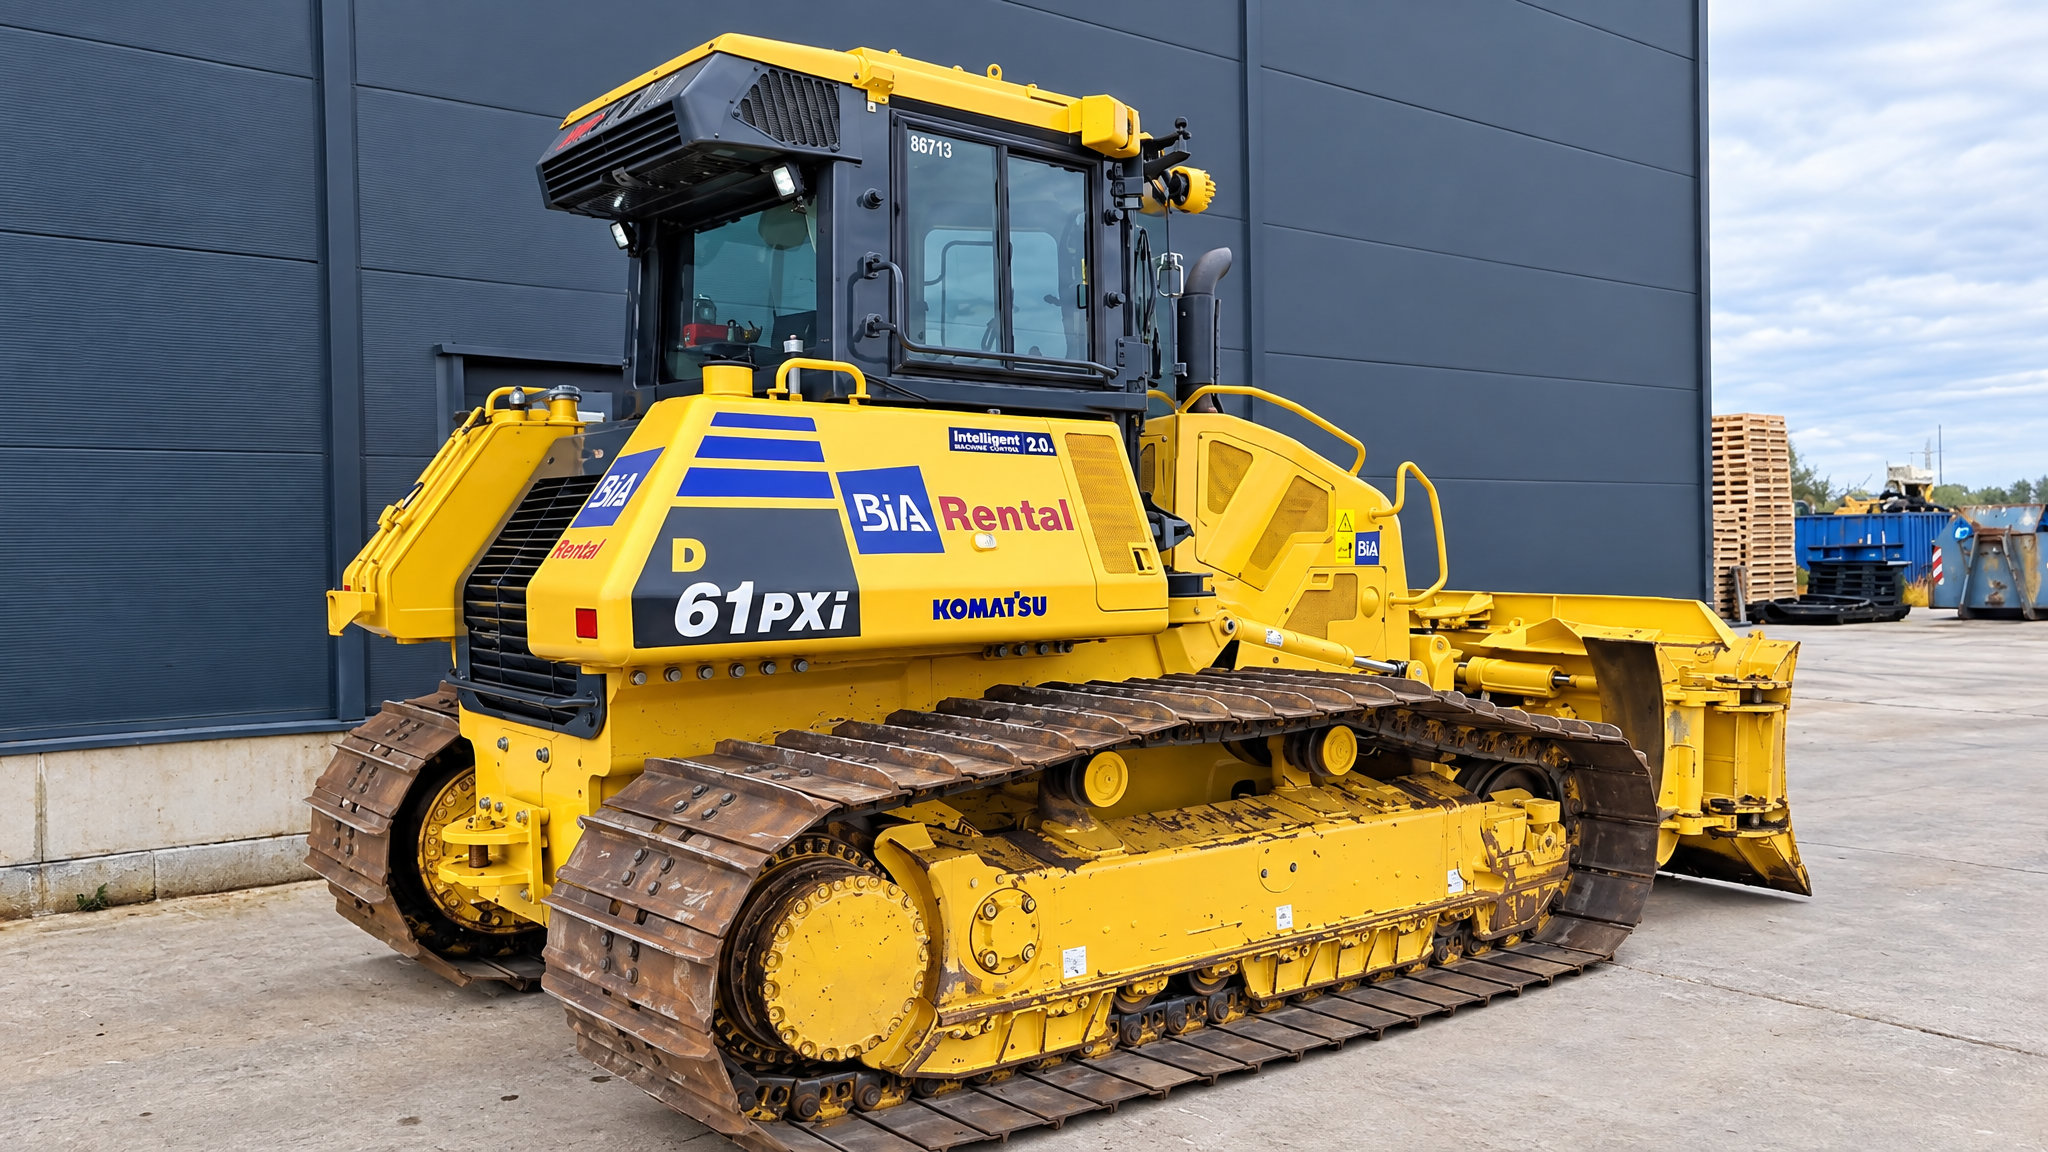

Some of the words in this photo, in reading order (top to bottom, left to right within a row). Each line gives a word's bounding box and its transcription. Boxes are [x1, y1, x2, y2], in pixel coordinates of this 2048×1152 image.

[910, 135, 952, 158] 86713
[953, 430, 1020, 446] Intelligent
[588, 473, 638, 508] BiA
[853, 493, 932, 532] BiA
[938, 496, 1074, 531] Rental
[551, 538, 607, 560] Rental
[671, 537, 707, 572] D
[1358, 540, 1379, 557] BiA
[933, 591, 1047, 620] KOMATSU
